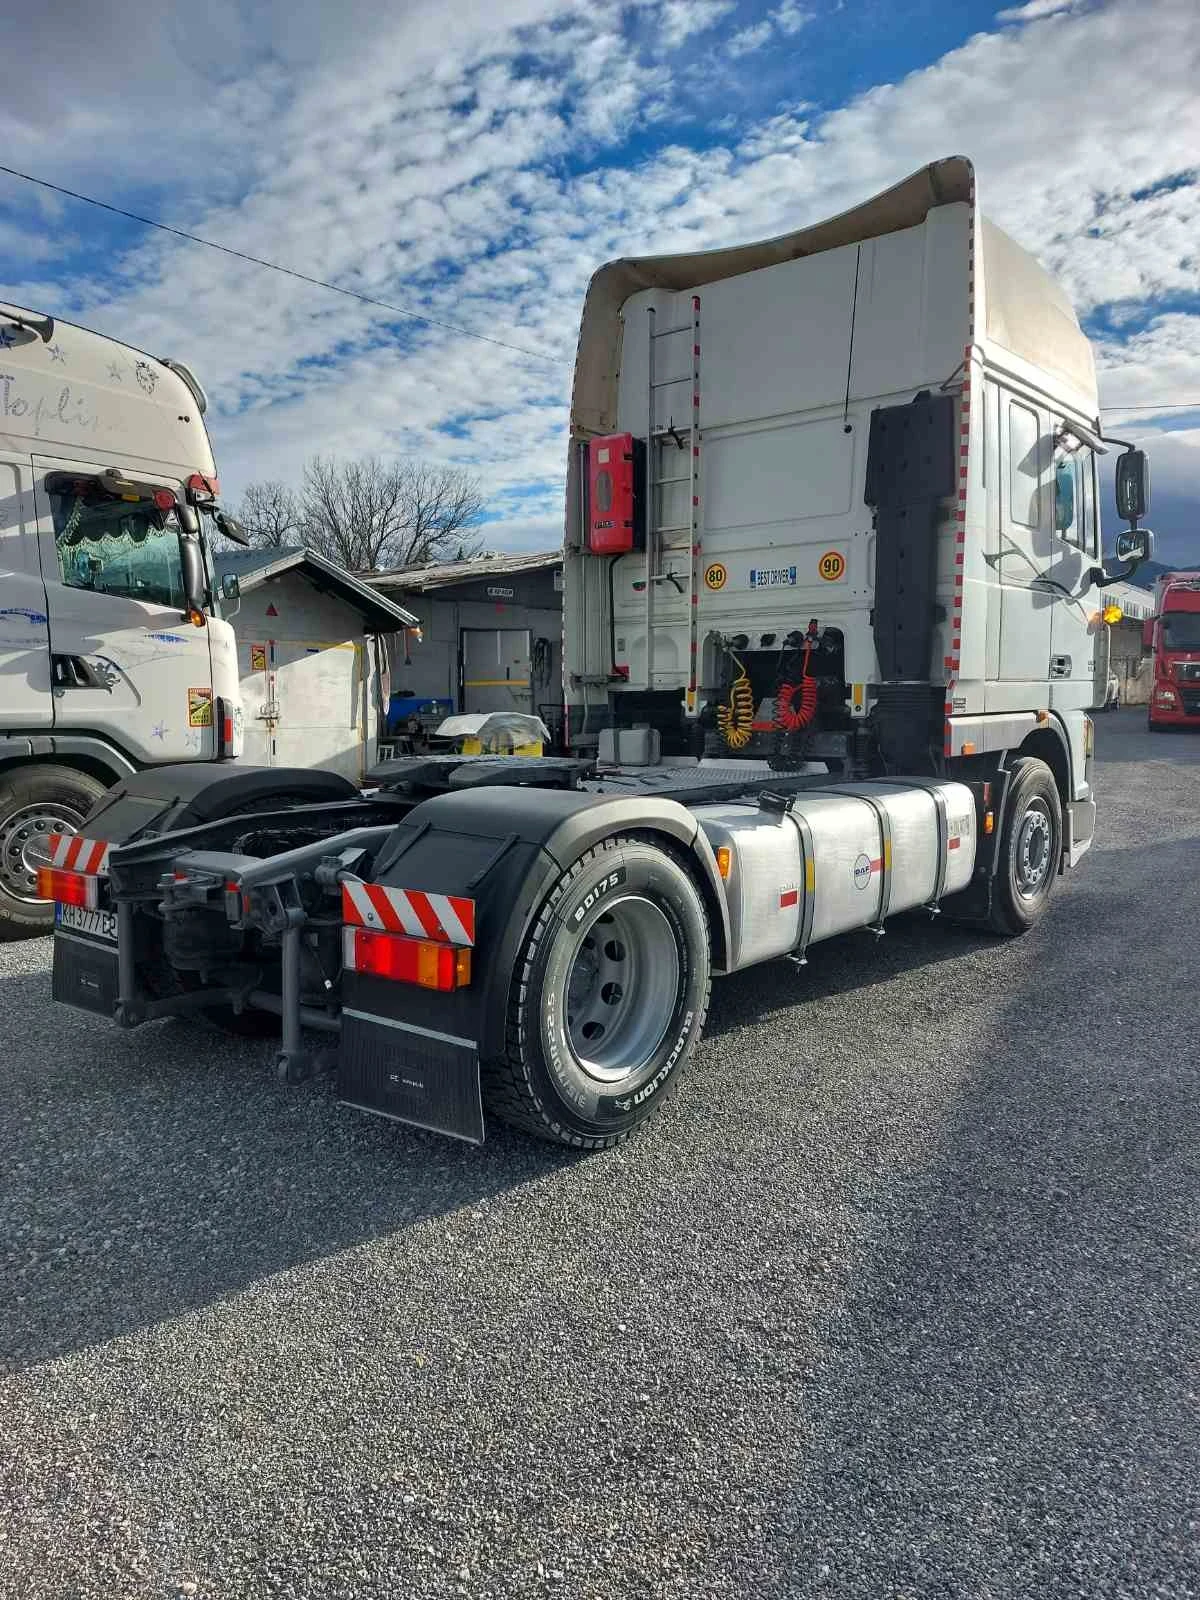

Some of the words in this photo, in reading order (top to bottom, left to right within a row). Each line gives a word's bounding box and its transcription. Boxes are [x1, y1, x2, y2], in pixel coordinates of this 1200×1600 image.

[823, 558, 840, 573] 90
[708, 569, 723, 583] 80
[757, 569, 771, 586] BEST
[771, 568, 789, 584] DRIVER
[855, 865, 870, 876] DAF
